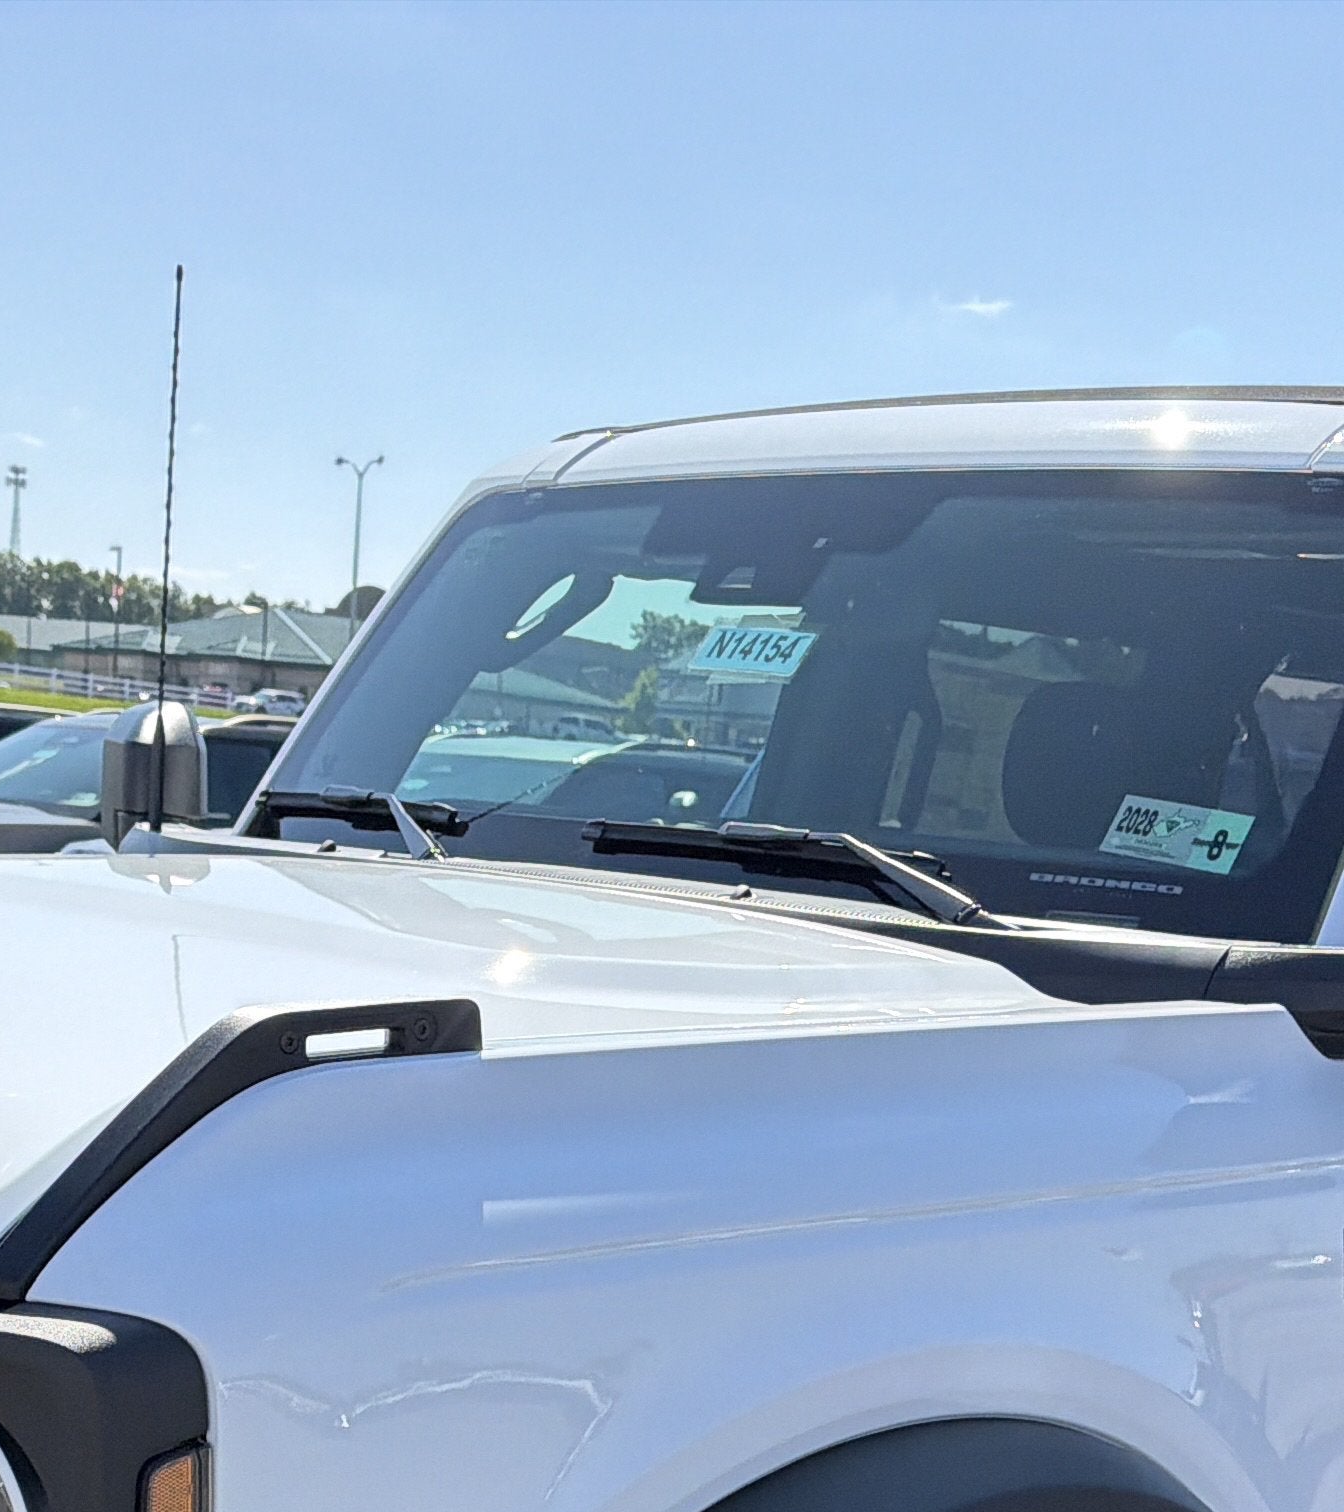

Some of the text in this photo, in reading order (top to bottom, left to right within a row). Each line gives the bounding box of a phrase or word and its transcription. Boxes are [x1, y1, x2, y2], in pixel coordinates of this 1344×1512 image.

[706, 630, 804, 664] N14154
[1115, 805, 1159, 837] 2028
[1206, 829, 1229, 861] 8
[1029, 873, 1183, 895] BRONCO
